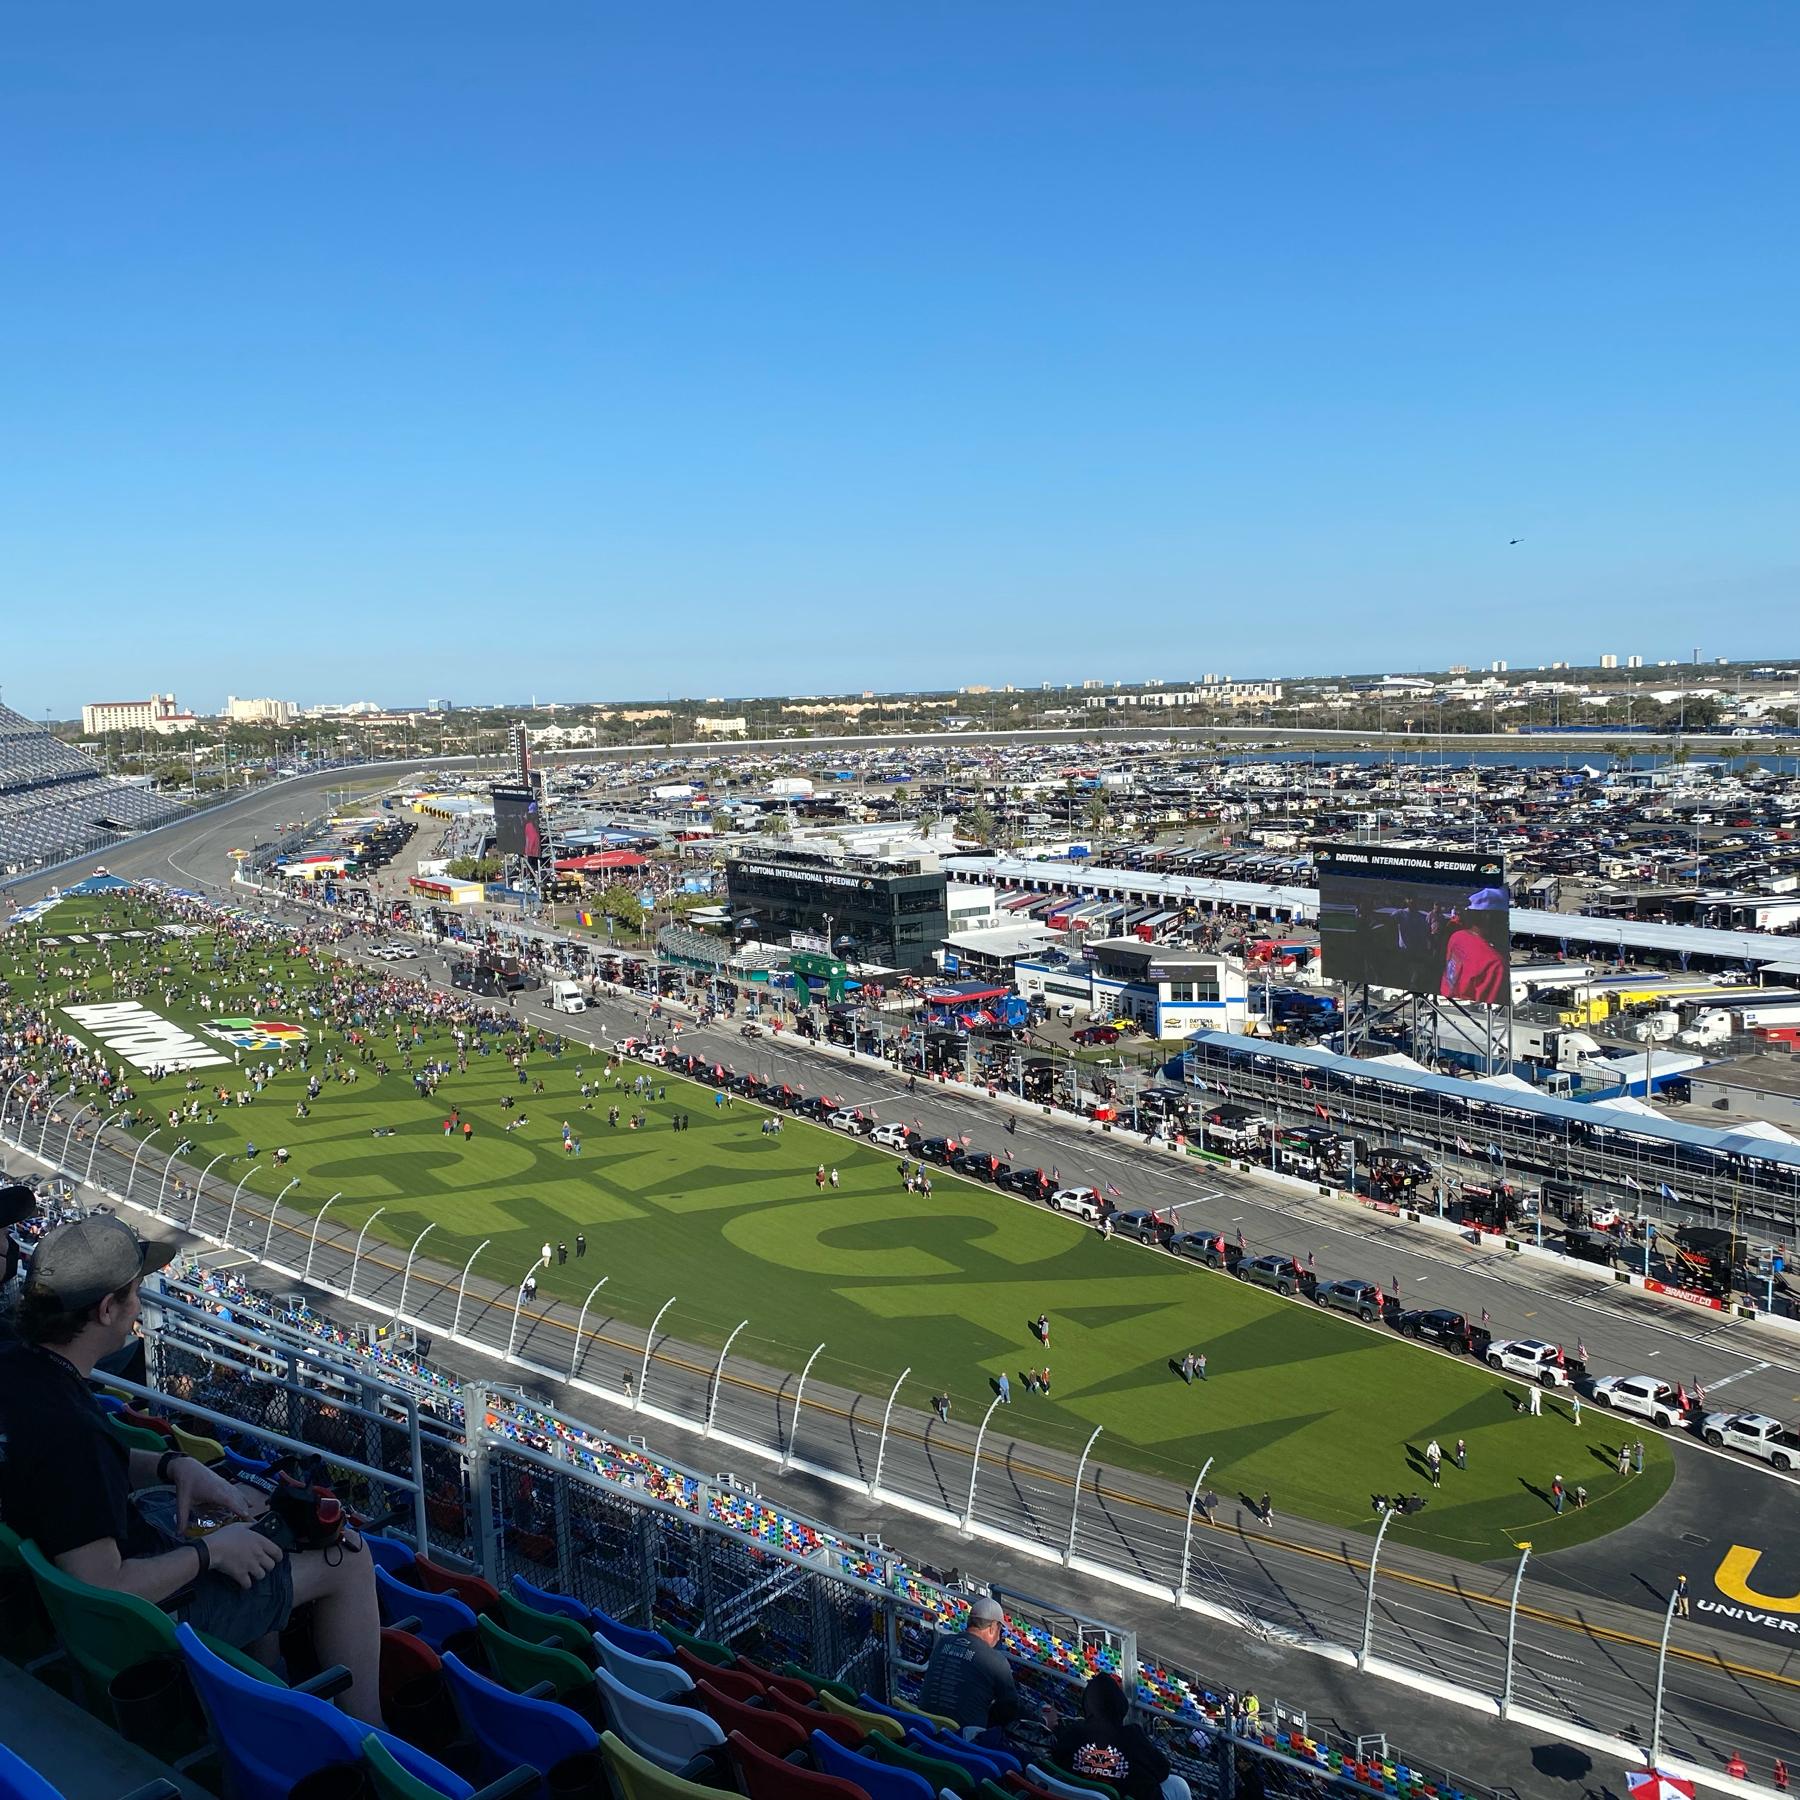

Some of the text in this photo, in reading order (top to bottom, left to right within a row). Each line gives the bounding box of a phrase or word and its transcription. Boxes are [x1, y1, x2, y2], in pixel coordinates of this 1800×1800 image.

[1336, 853, 1477, 872] DAYTONA INTERNATIONAL SPEEDWAY
[750, 865, 859, 888] DAYTONA INTERNATIONAL SPEEDWAY
[60, 1000, 233, 1076] DAYTONA
[1663, 1286, 1712, 1306] BRANDT.CO
[1696, 1599, 1800, 1633] UNIVER
[1073, 1764, 1129, 1779] CHEVROLET
